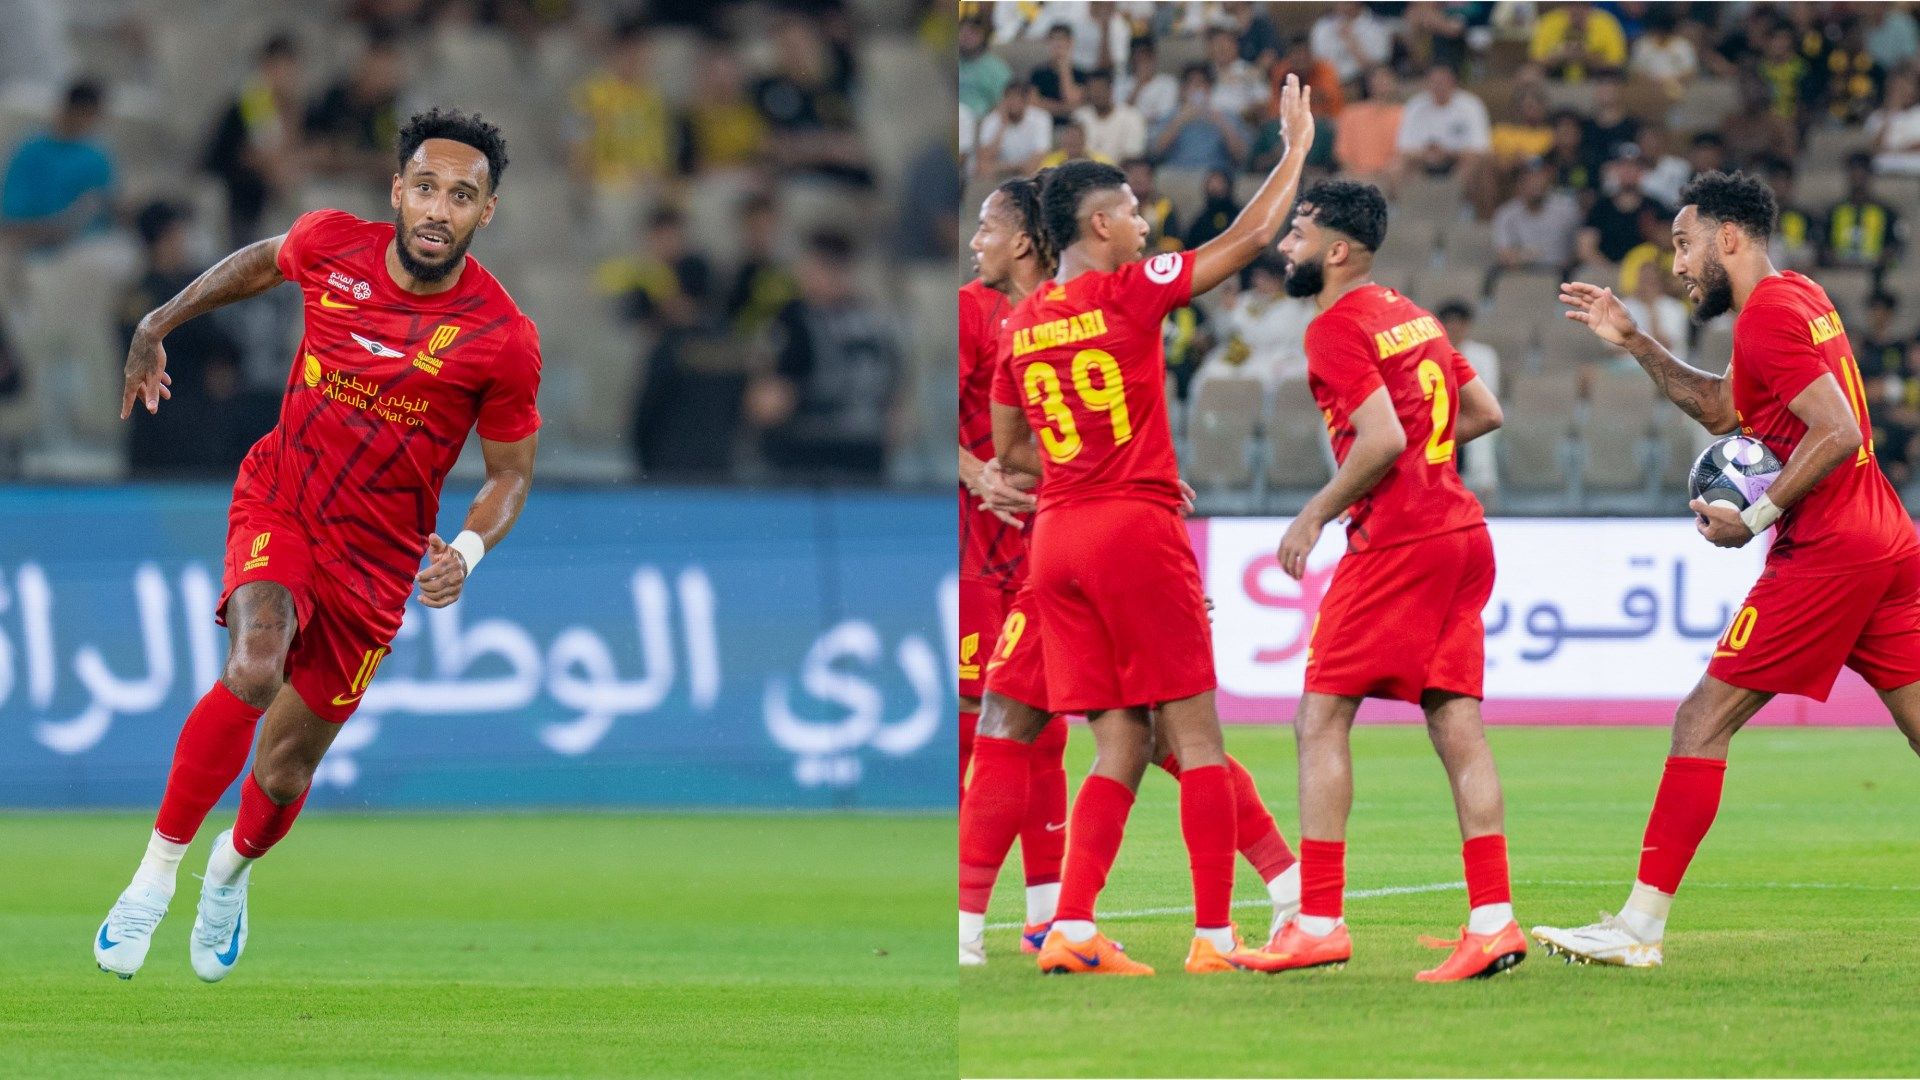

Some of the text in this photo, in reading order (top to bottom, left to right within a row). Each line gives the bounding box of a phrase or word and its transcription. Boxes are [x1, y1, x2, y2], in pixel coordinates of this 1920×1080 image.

[328, 279, 349, 292] almana
[1013, 308, 1108, 357] ALDOSARI
[326, 369, 378, 397] للطيران
[412, 358, 440, 376] QADSIAH
[322, 384, 367, 410] Aloula
[1023, 348, 1133, 464] 39
[1418, 359, 1455, 465] 2
[1721, 605, 1758, 651] 10
[351, 647, 387, 693] 10
